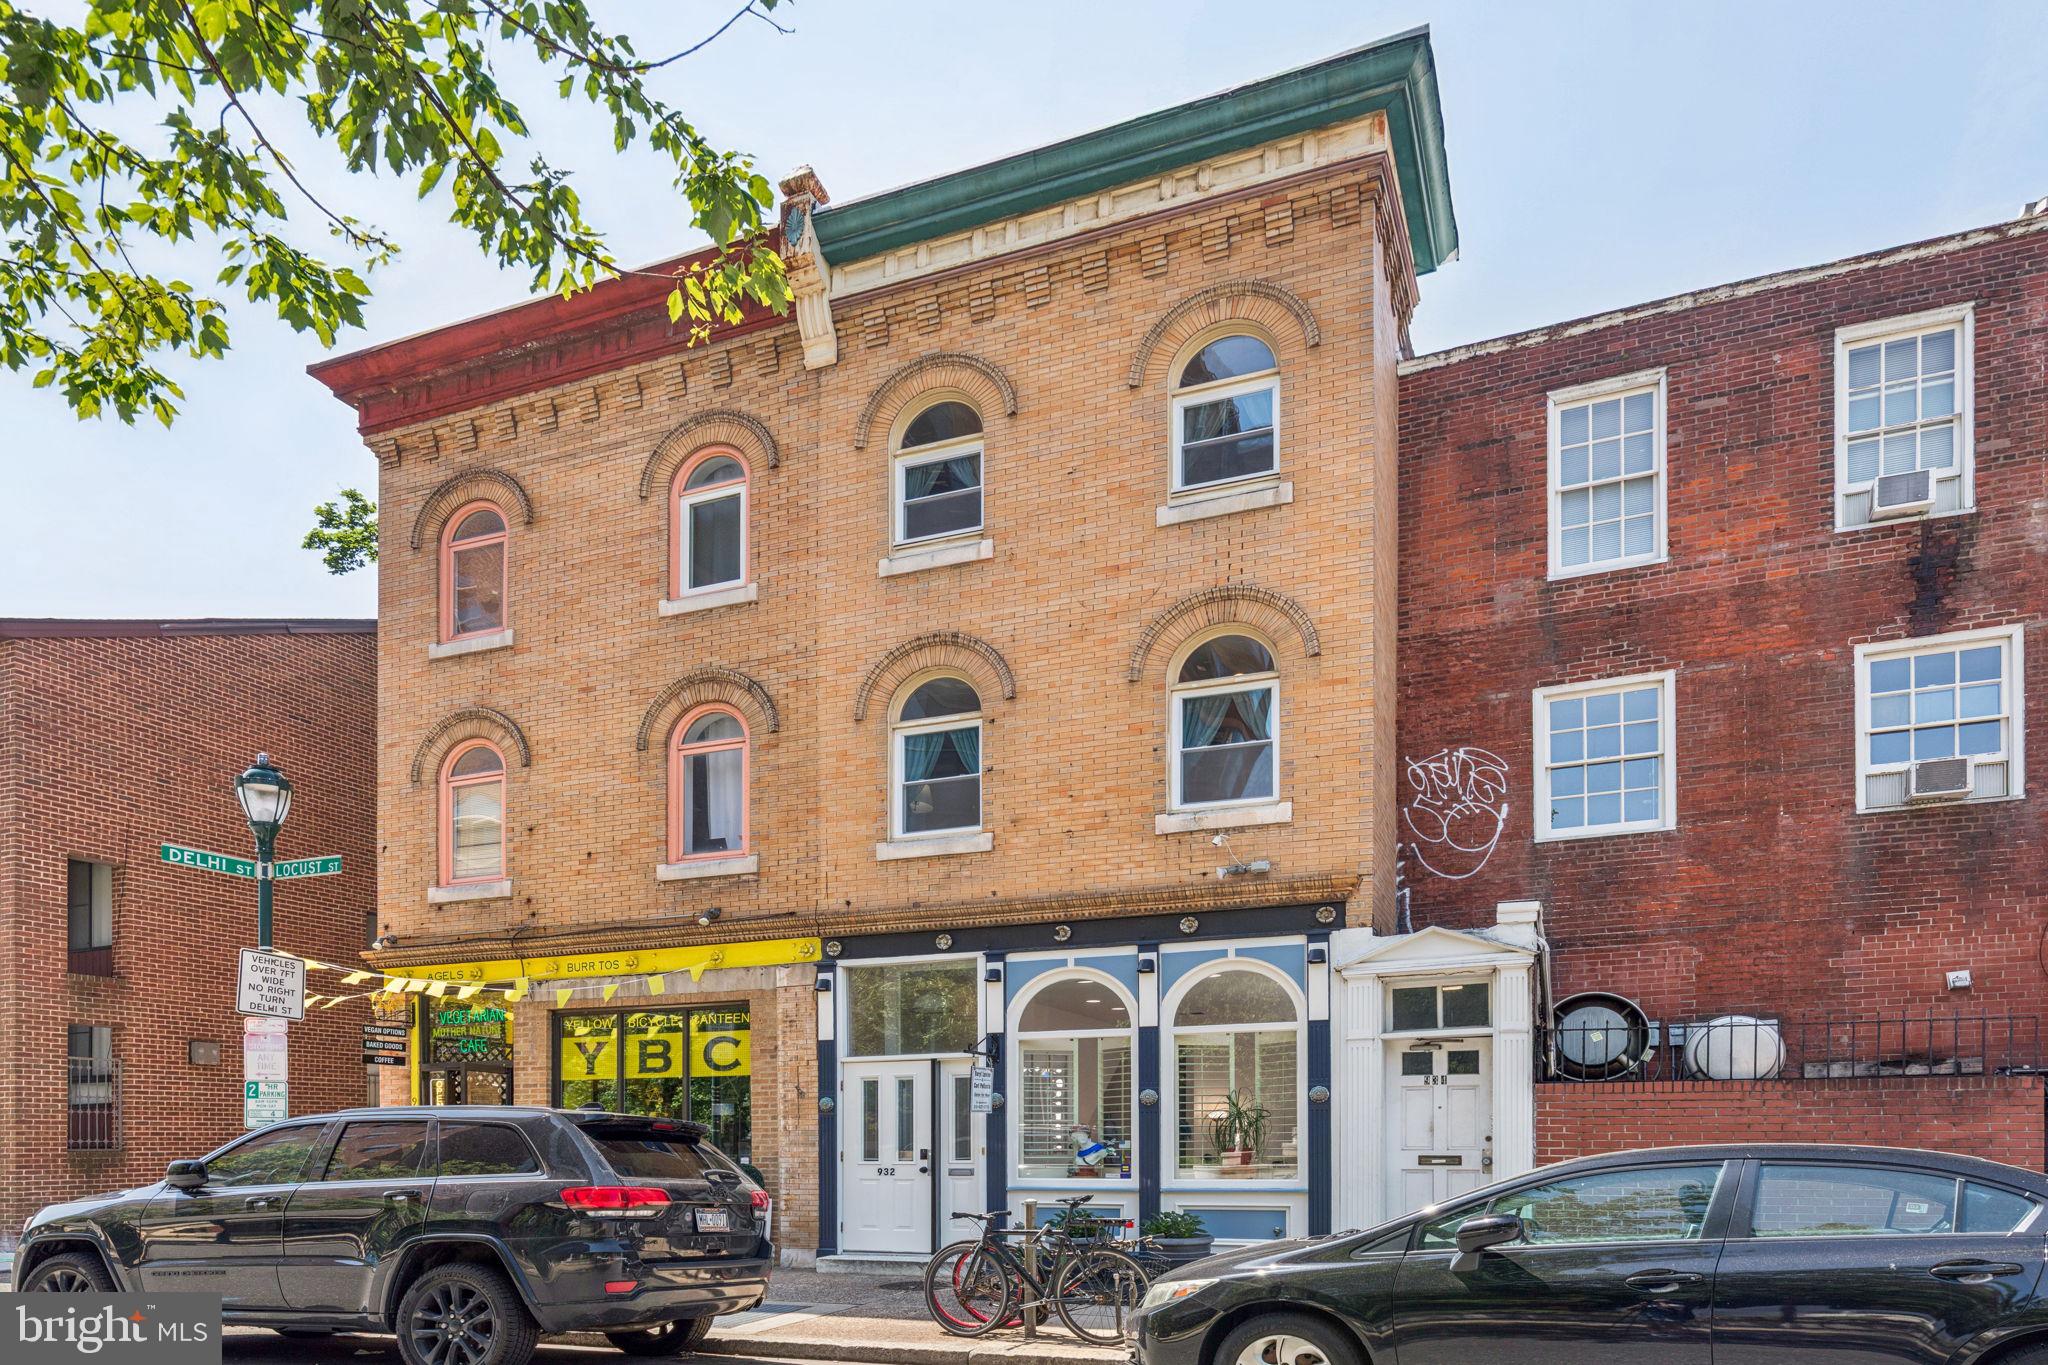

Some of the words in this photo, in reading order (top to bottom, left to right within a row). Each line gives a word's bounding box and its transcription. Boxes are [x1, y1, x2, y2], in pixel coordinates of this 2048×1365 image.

[169, 848, 226, 871] DELHI
[236, 864, 252, 876] ST
[276, 861, 323, 877] LOCUST
[328, 862, 340, 872] ST
[251, 954, 296, 970] VEHICLES
[250, 964, 276, 976] OVER
[280, 969, 295, 979] 7FT
[261, 975, 285, 986] WIDE
[248, 982, 264, 992] NO
[267, 986, 296, 997] RIGHT
[259, 993, 286, 1005] TURN
[249, 1002, 278, 1013] DELHI
[281, 1006, 293, 1015] ST
[439, 1008, 506, 1025] VEGETARIAN
[565, 1018, 613, 1030] YELLOW
[628, 1014, 680, 1028] BICYCLE
[690, 1012, 750, 1026] CANTEEN
[364, 1026, 382, 1035] VEGAN
[382, 1028, 406, 1037] OPTIONS
[432, 1027, 467, 1038] MOTHER
[365, 1041, 384, 1050] BAKED
[384, 1042, 403, 1051] GOODS
[459, 1038, 488, 1053] CAFE
[574, 1041, 608, 1075] Y
[638, 1039, 673, 1074] B
[703, 1036, 742, 1072] C
[257, 1062, 277, 1070] TIME
[248, 1084, 257, 1097] 2
[259, 1090, 285, 1098] PARKING
[877, 1167, 895, 1176] 932
